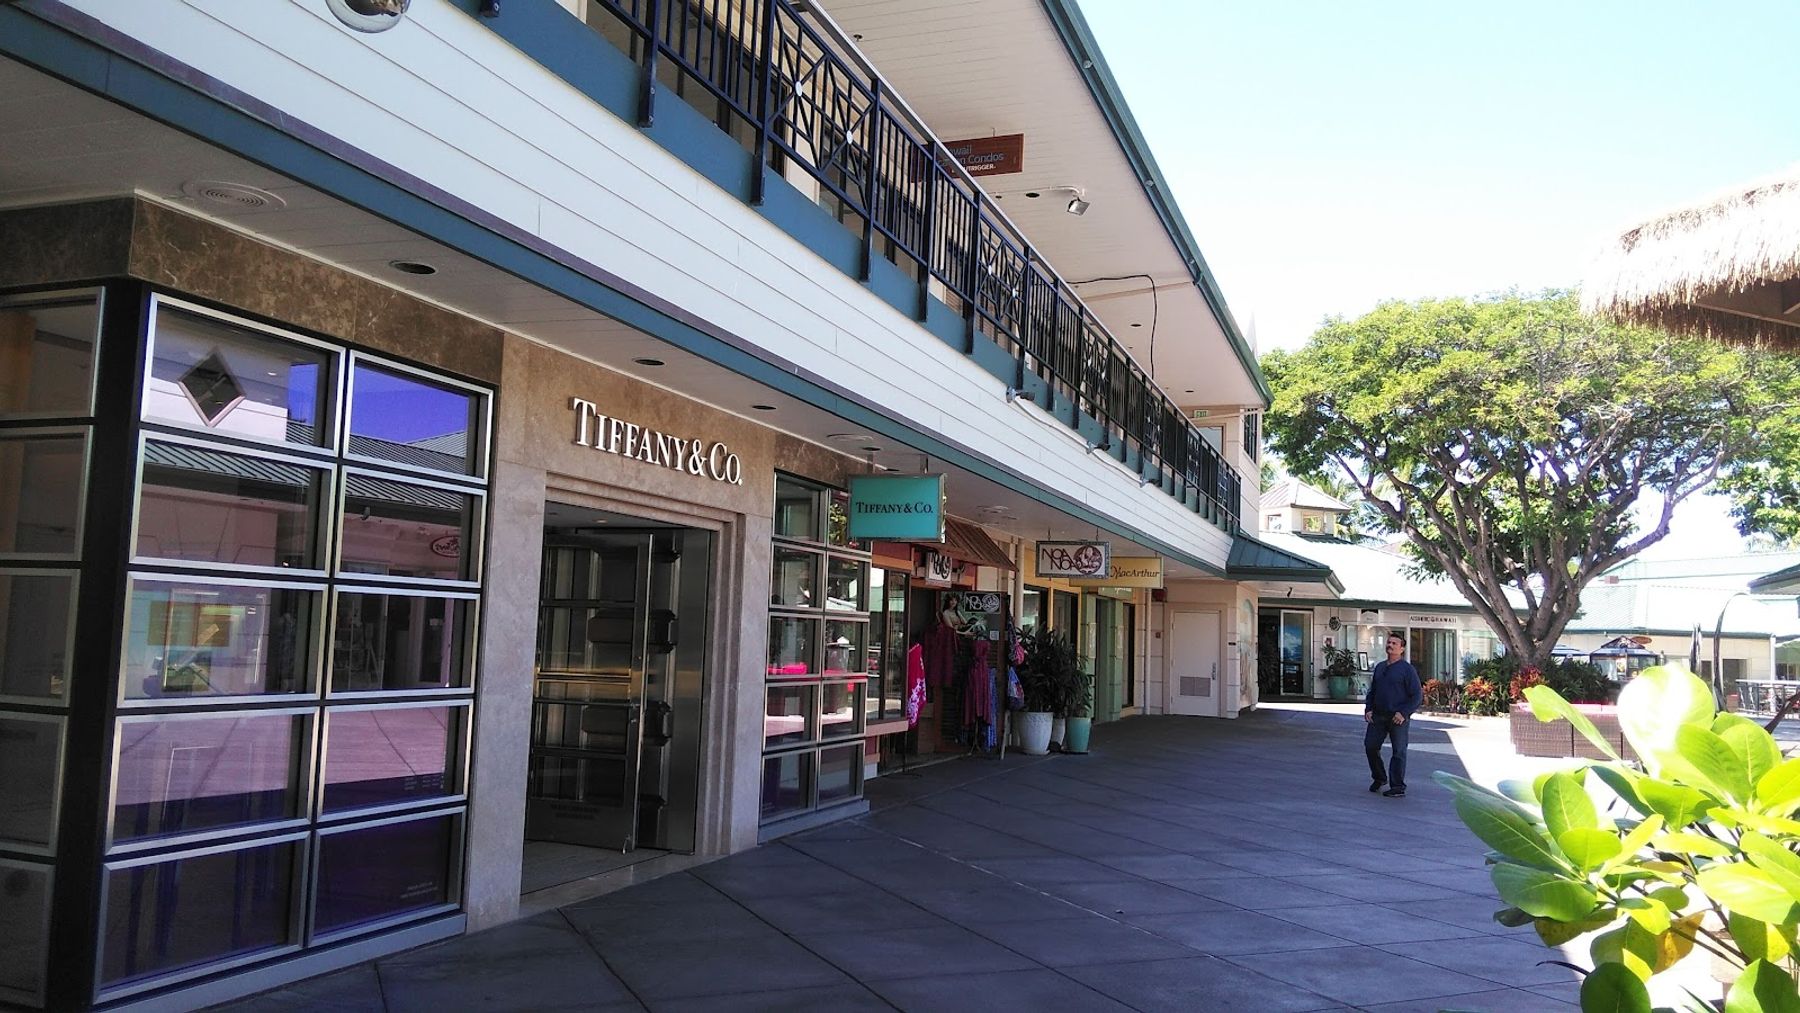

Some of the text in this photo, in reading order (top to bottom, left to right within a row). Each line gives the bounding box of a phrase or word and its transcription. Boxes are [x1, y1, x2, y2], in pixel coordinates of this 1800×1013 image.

[968, 152, 1005, 164] Condos
[1042, 548, 1071, 561] NOA
[1050, 558, 1081, 571] NOA
